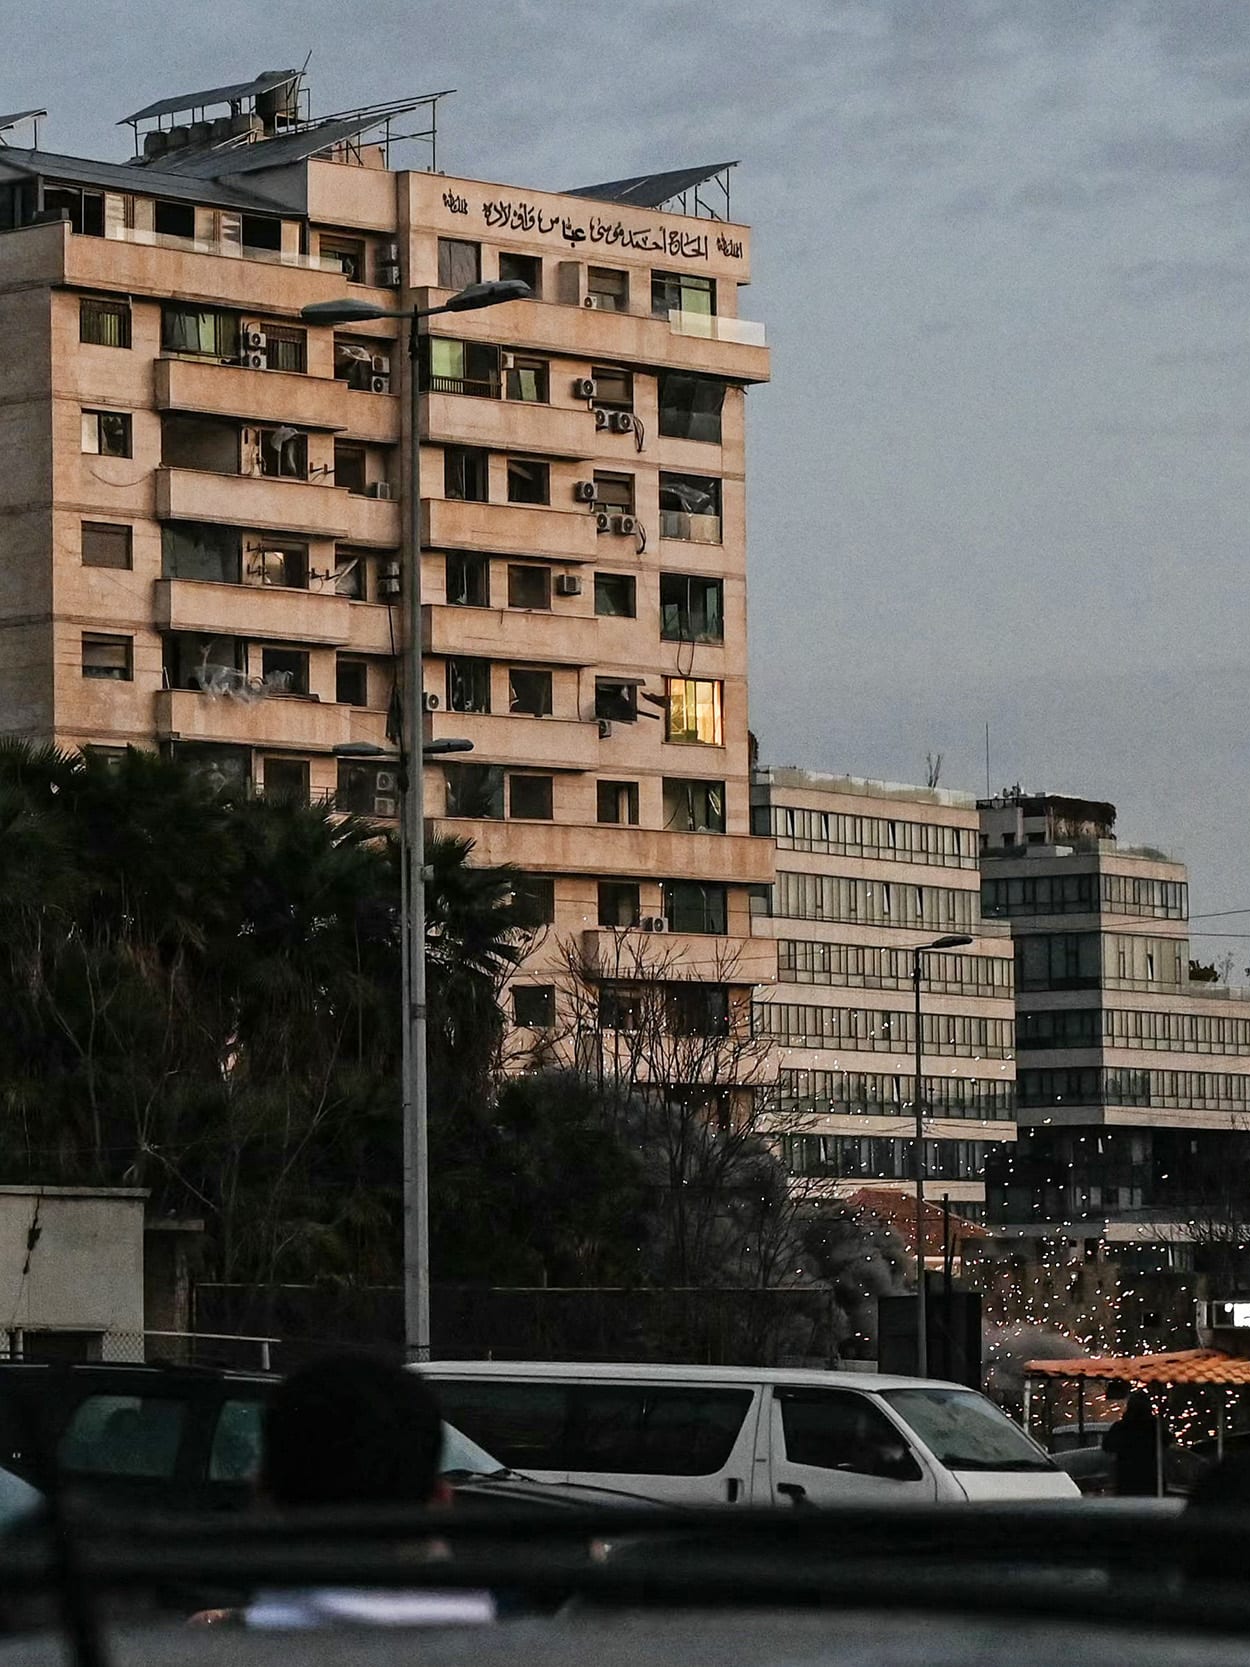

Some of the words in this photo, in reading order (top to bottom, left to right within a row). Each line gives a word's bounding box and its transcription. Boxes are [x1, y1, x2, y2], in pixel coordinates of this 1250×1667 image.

[482, 200, 535, 232] وأولاده
[537, 209, 587, 248] عباس
[589, 216, 625, 244] موسى
[621, 226, 667, 254] أحمد
[667, 230, 708, 261] الحاج
